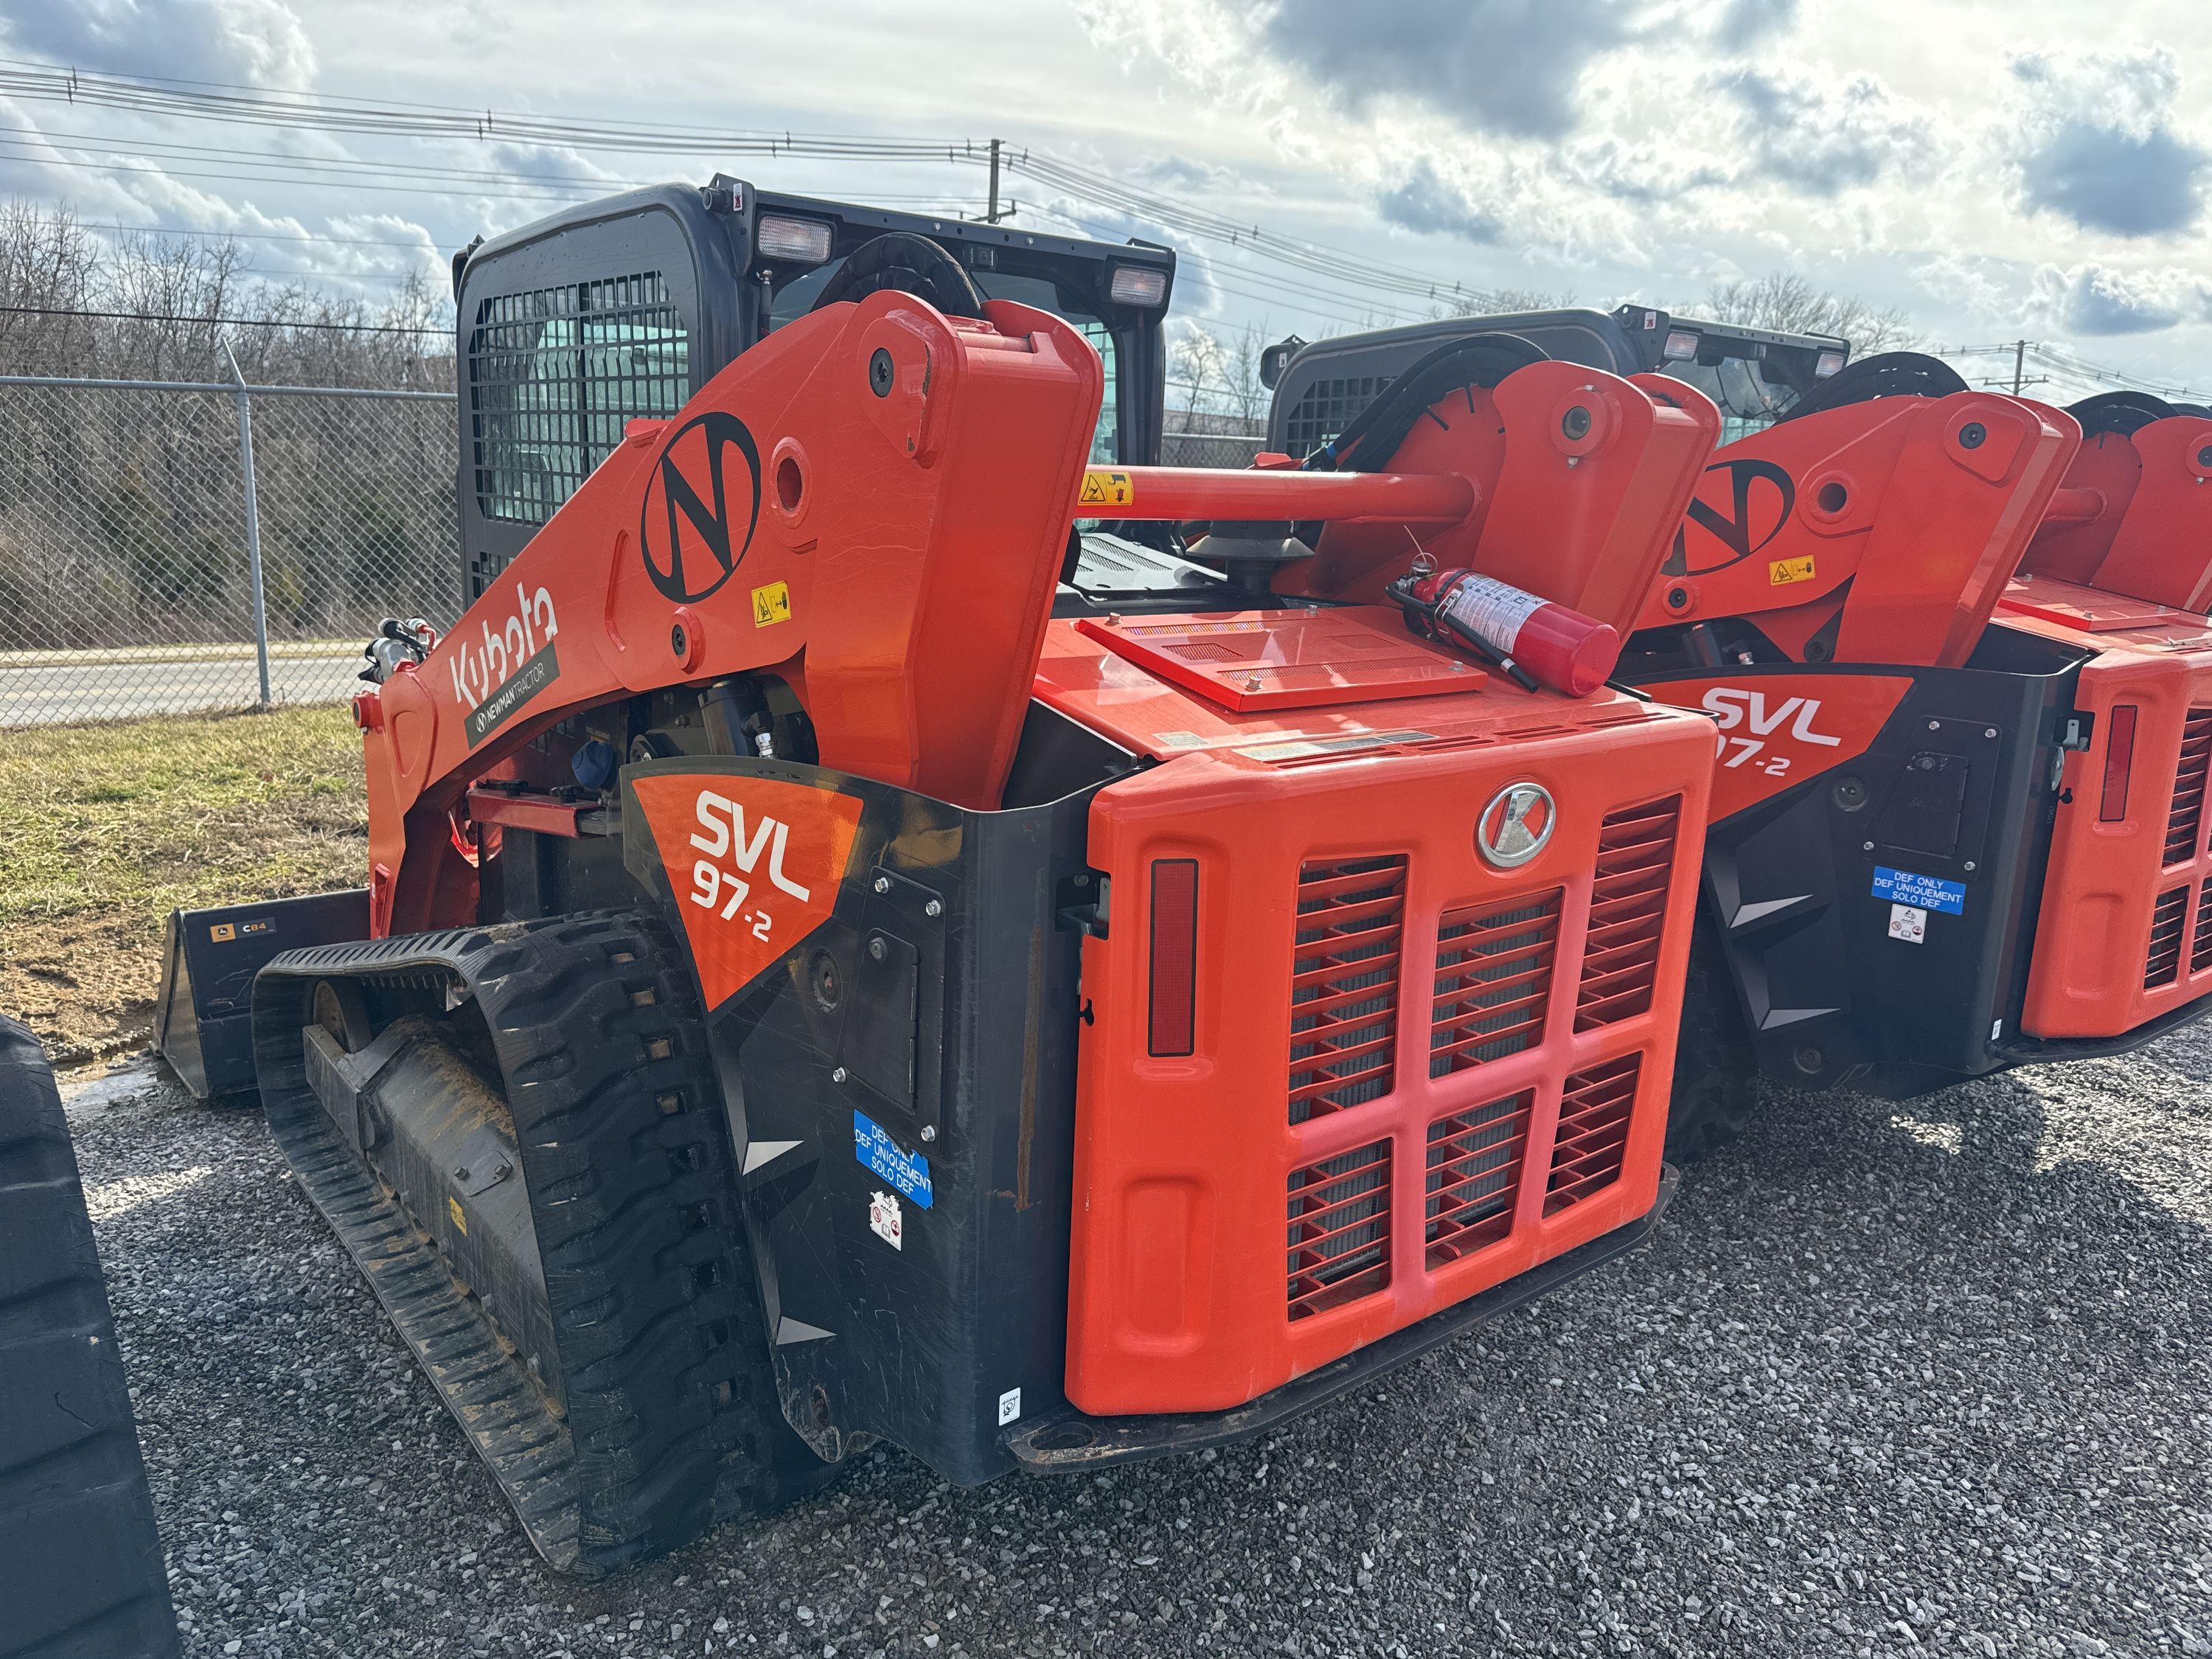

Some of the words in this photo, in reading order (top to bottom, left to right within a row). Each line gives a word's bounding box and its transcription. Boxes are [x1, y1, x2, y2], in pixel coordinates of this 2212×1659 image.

[449, 581, 558, 710] Kubota
[1702, 686, 1842, 746] SVL
[690, 790, 810, 902] SVL
[1874, 877, 1894, 888] DEF
[1896, 882, 1962, 903] UNIQUEMENT
[1892, 891, 1918, 903] SOLO
[1920, 897, 1941, 908] DEF
[1894, 872, 1914, 883] DEF
[1917, 877, 1944, 889] ONLY
[690, 860, 772, 943] 97-2
[243, 922, 266, 933] C84
[872, 1124, 888, 1144] DEF
[855, 1129, 872, 1149] DEF
[874, 1141, 932, 1193] UNIQUEMENT
[871, 1156, 894, 1181] SOLO
[896, 1173, 914, 1194] DEF
